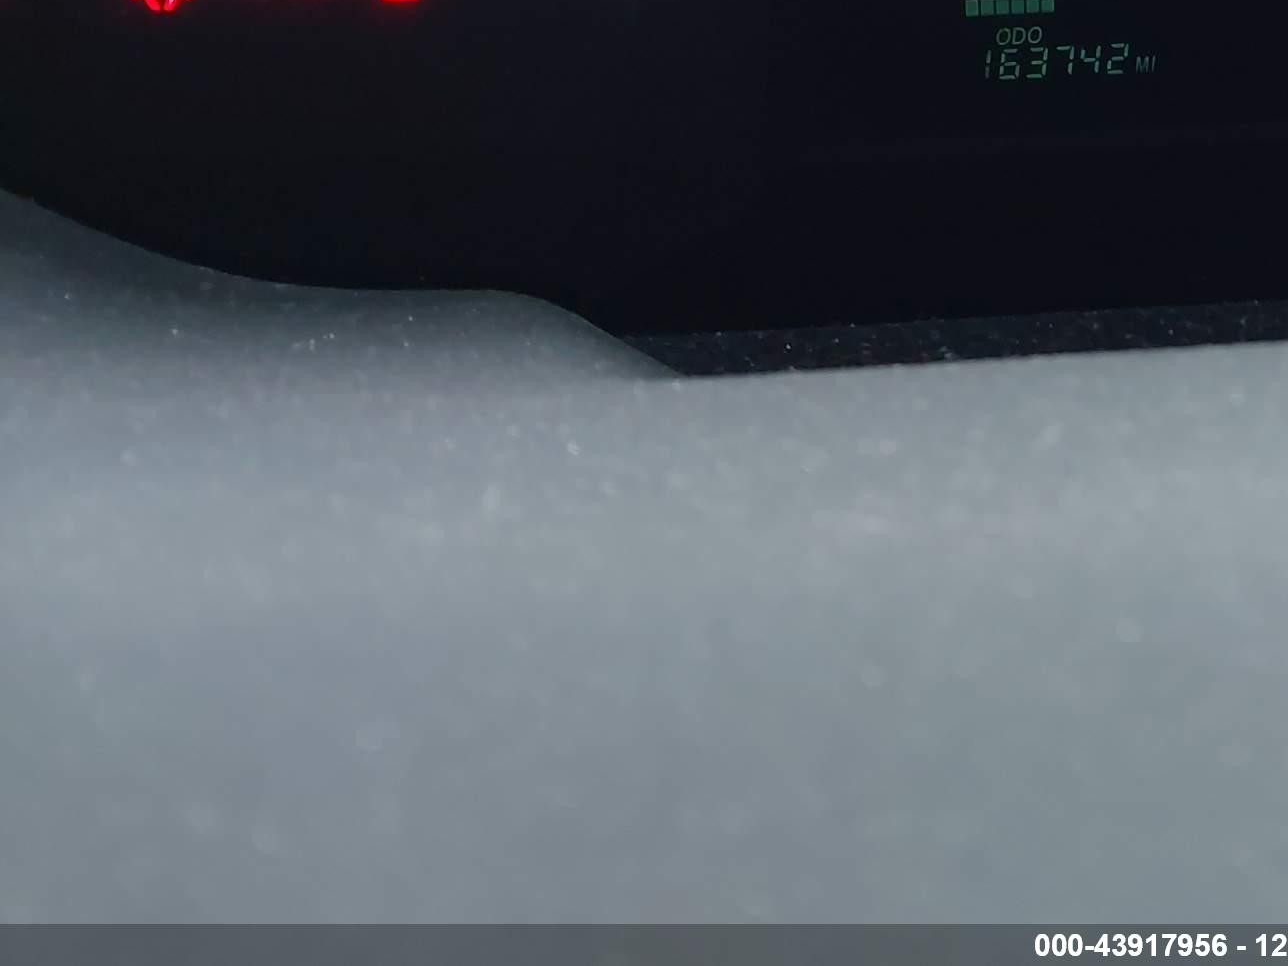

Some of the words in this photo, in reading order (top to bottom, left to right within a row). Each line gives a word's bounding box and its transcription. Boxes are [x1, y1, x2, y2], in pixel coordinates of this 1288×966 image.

[995, 26, 1043, 45] ODO
[983, 42, 1131, 80] 163742
[1135, 54, 1158, 74] MI
